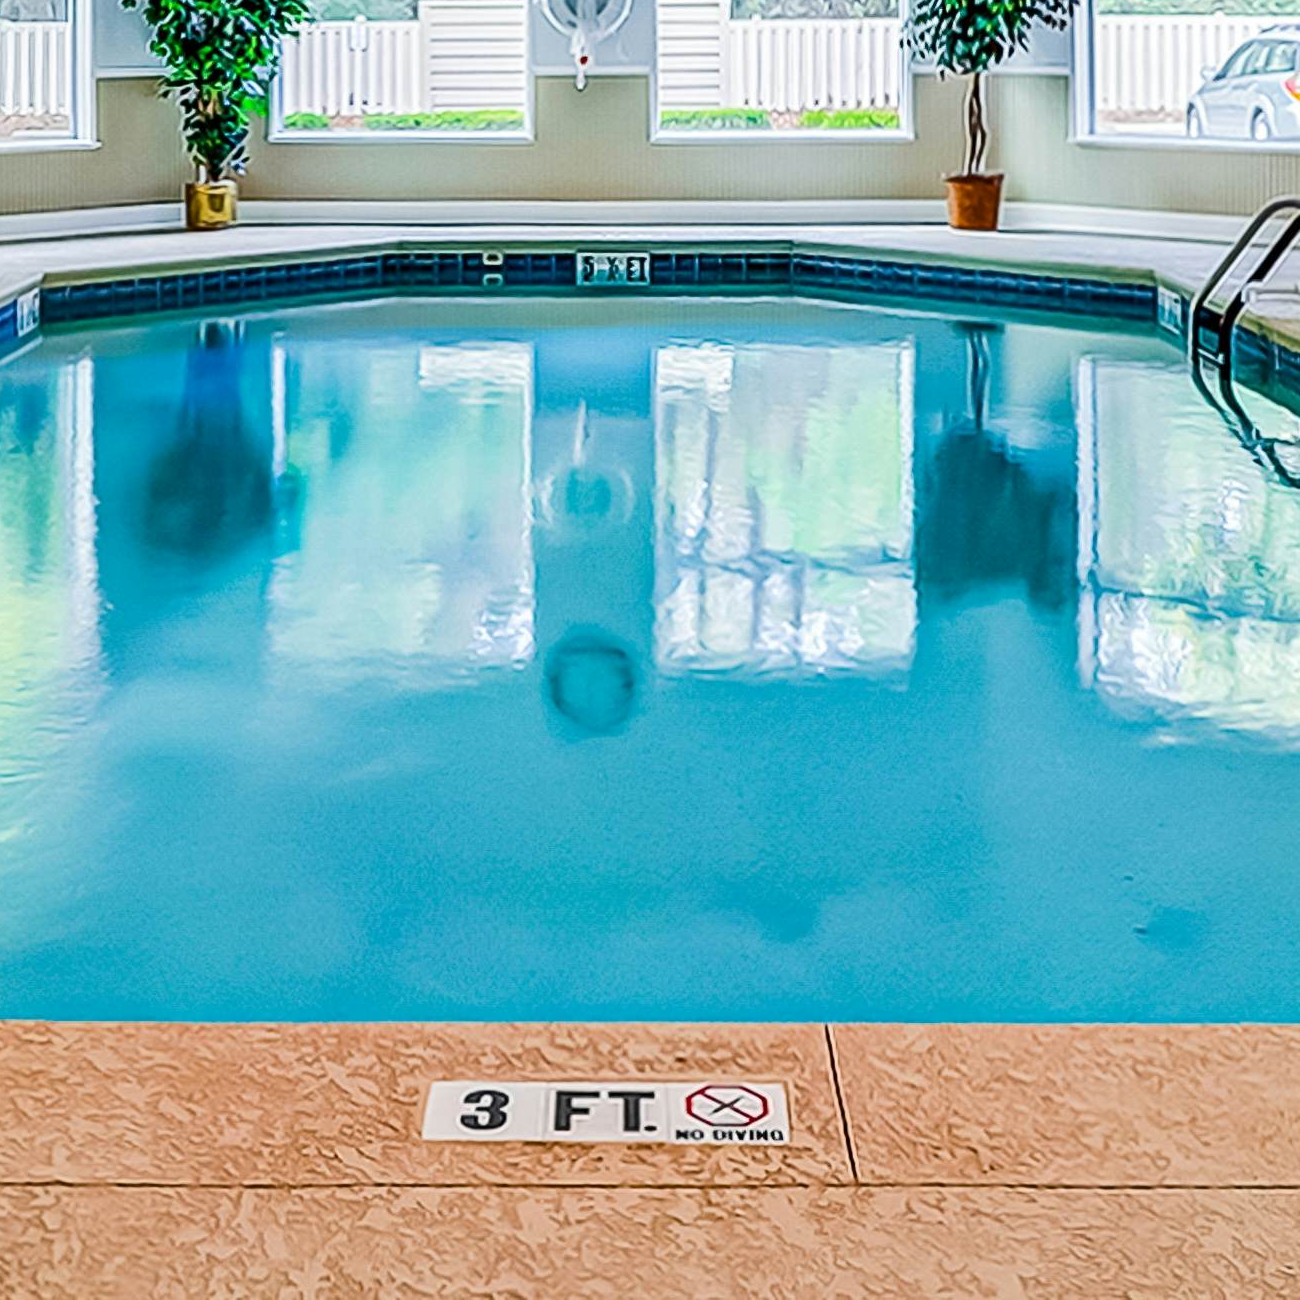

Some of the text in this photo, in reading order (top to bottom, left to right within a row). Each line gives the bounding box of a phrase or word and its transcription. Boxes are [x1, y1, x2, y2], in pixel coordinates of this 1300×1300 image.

[460, 1090, 658, 1132] 3 FT.
[675, 1129, 784, 1141] NO DIVING
